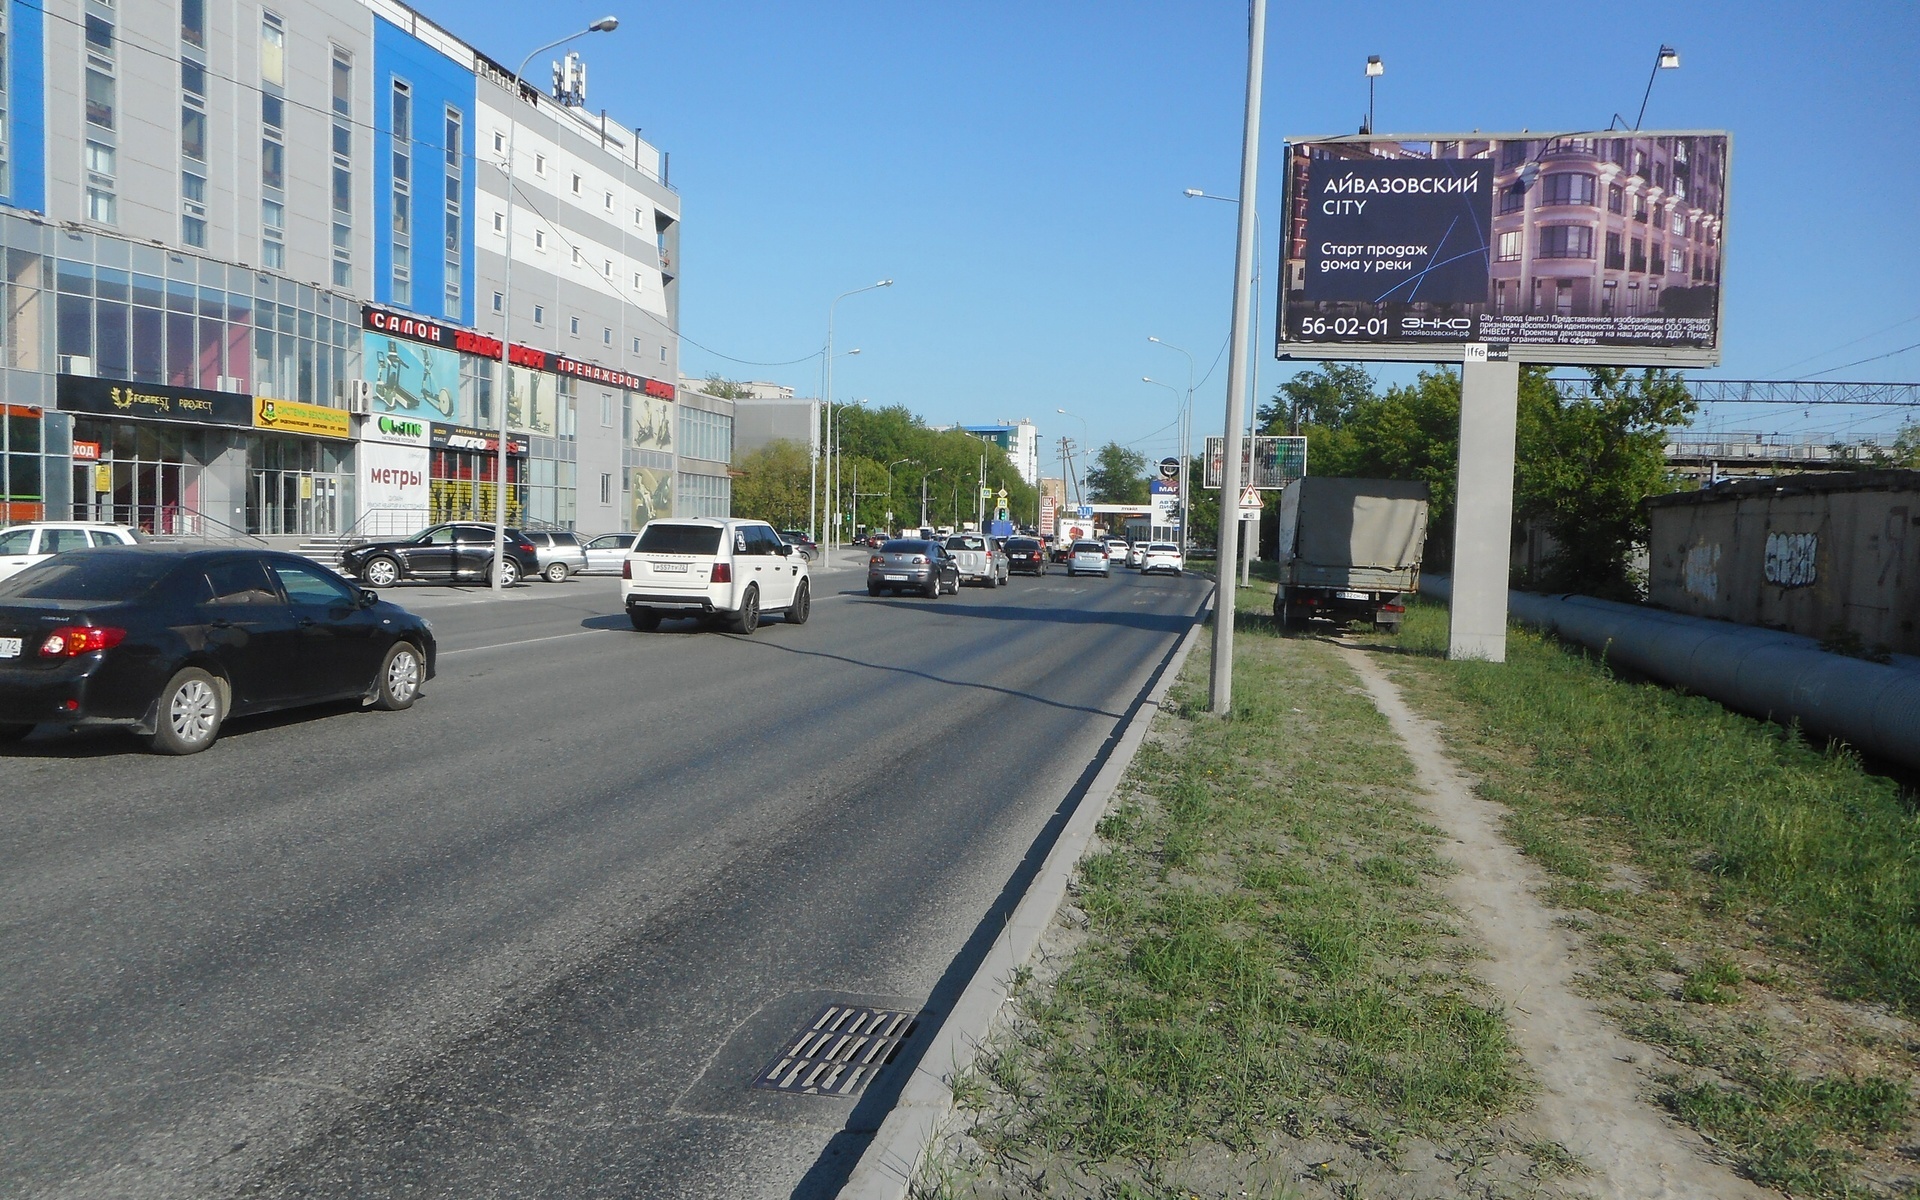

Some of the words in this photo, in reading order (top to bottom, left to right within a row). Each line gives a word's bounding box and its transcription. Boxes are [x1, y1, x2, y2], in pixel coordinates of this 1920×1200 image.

[1323, 170, 1479, 194] АЙВАЗОВСКИЙ
[1322, 200, 1367, 215] CITY
[1321, 242, 1364, 257] Старт
[1366, 245, 1428, 258] продаж
[1320, 260, 1360, 273] дома
[1363, 260, 1373, 272] у
[1375, 260, 1412, 272] реки
[1401, 317, 1471, 329] ЭНКО
[1479, 313, 1494, 322] City
[1502, 315, 1523, 323] город
[1525, 314, 1549, 323] (англ.)
[1551, 315, 1612, 324] Представленное
[1613, 315, 1664, 324] изображение
[1301, 317, 1388, 335] 56-02-01
[1520, 322, 1563, 330] абсолютной
[1617, 323, 1664, 332] Застройщик
[1664, 323, 1682, 331] ООО
[1401, 329, 1471, 338] этоайвазовский.рф
[1479, 328, 1517, 336] ИНВЕСТ».
[1519, 328, 1558, 337] Проектная
[1559, 330, 1604, 338] декларация
[1686, 331, 1710, 340] Пред-
[1511, 336, 1556, 344] ограничено.
[372, 312, 440, 342] САЛОН
[454, 330, 546, 370] ТЕХНОПОРТ
[557, 357, 640, 390] ТРЕНАЖЕРОВ
[73, 445, 95, 457] ХОД
[371, 467, 422, 491] метры
